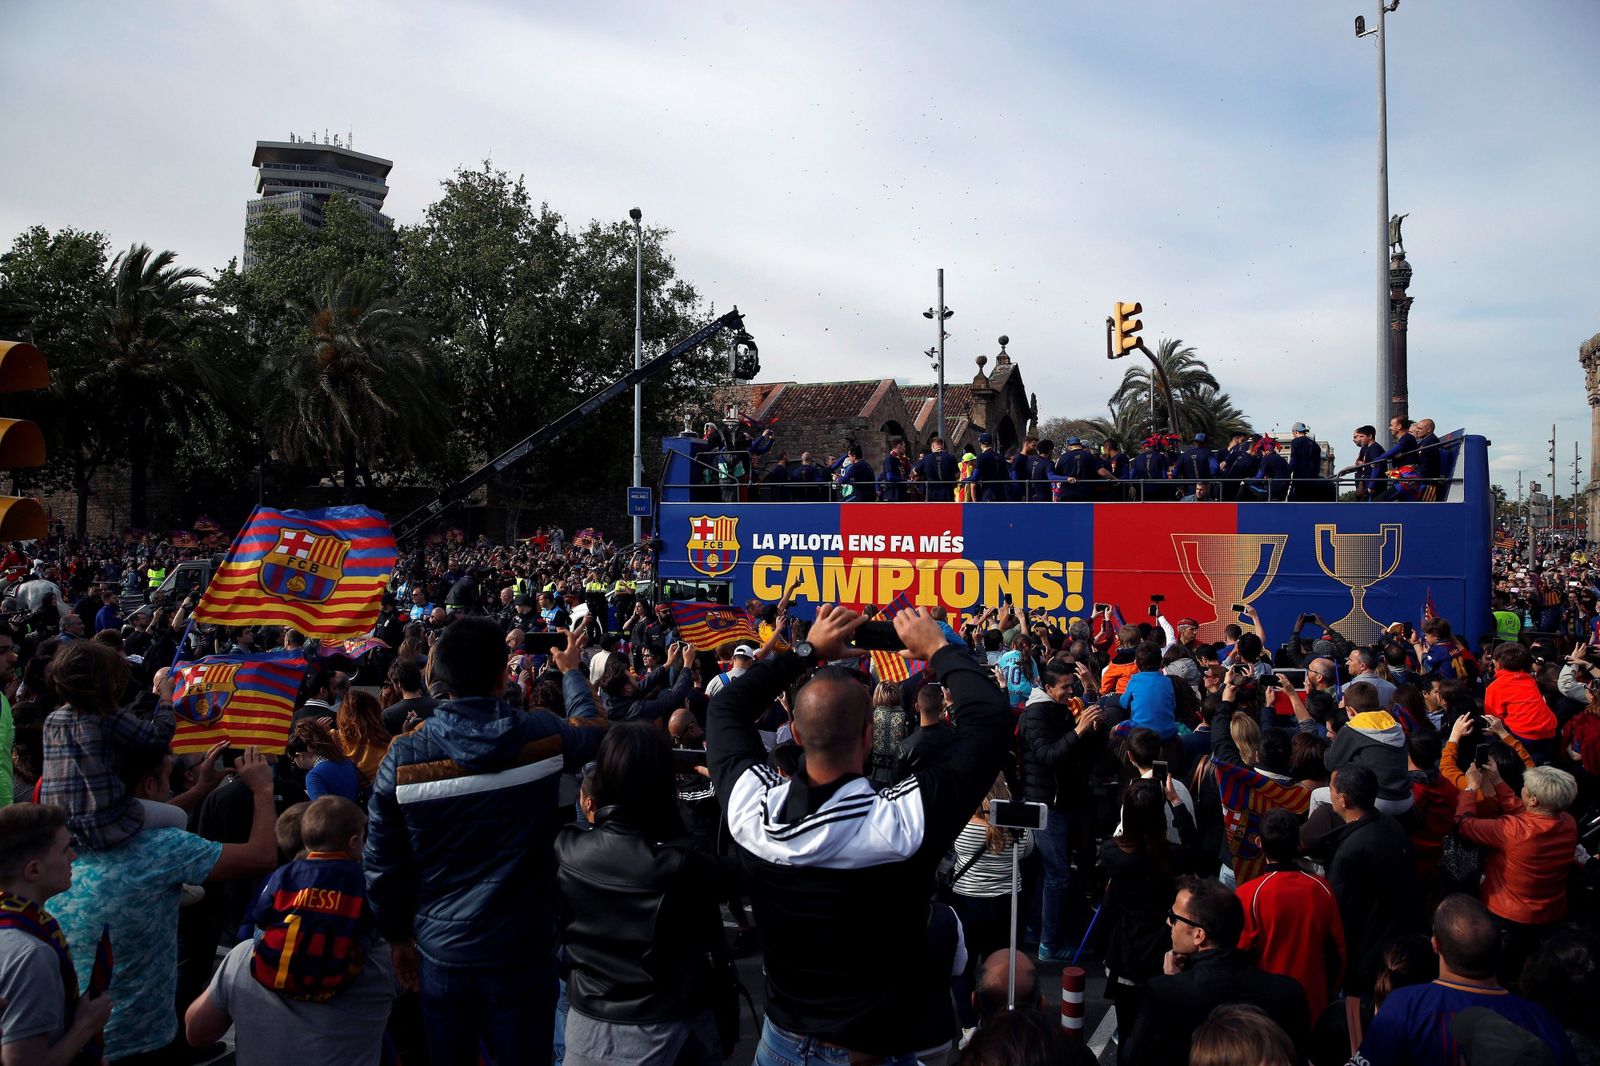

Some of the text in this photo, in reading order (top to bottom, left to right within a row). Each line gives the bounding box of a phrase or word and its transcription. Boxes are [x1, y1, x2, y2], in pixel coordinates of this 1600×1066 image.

[703, 541, 724, 549] FCB
[753, 530, 964, 553] LA PILOTA ENS FA MÉS
[286, 556, 320, 573] FCB
[752, 554, 1084, 612] CAMPIONS!
[292, 887, 342, 911] MESSI
